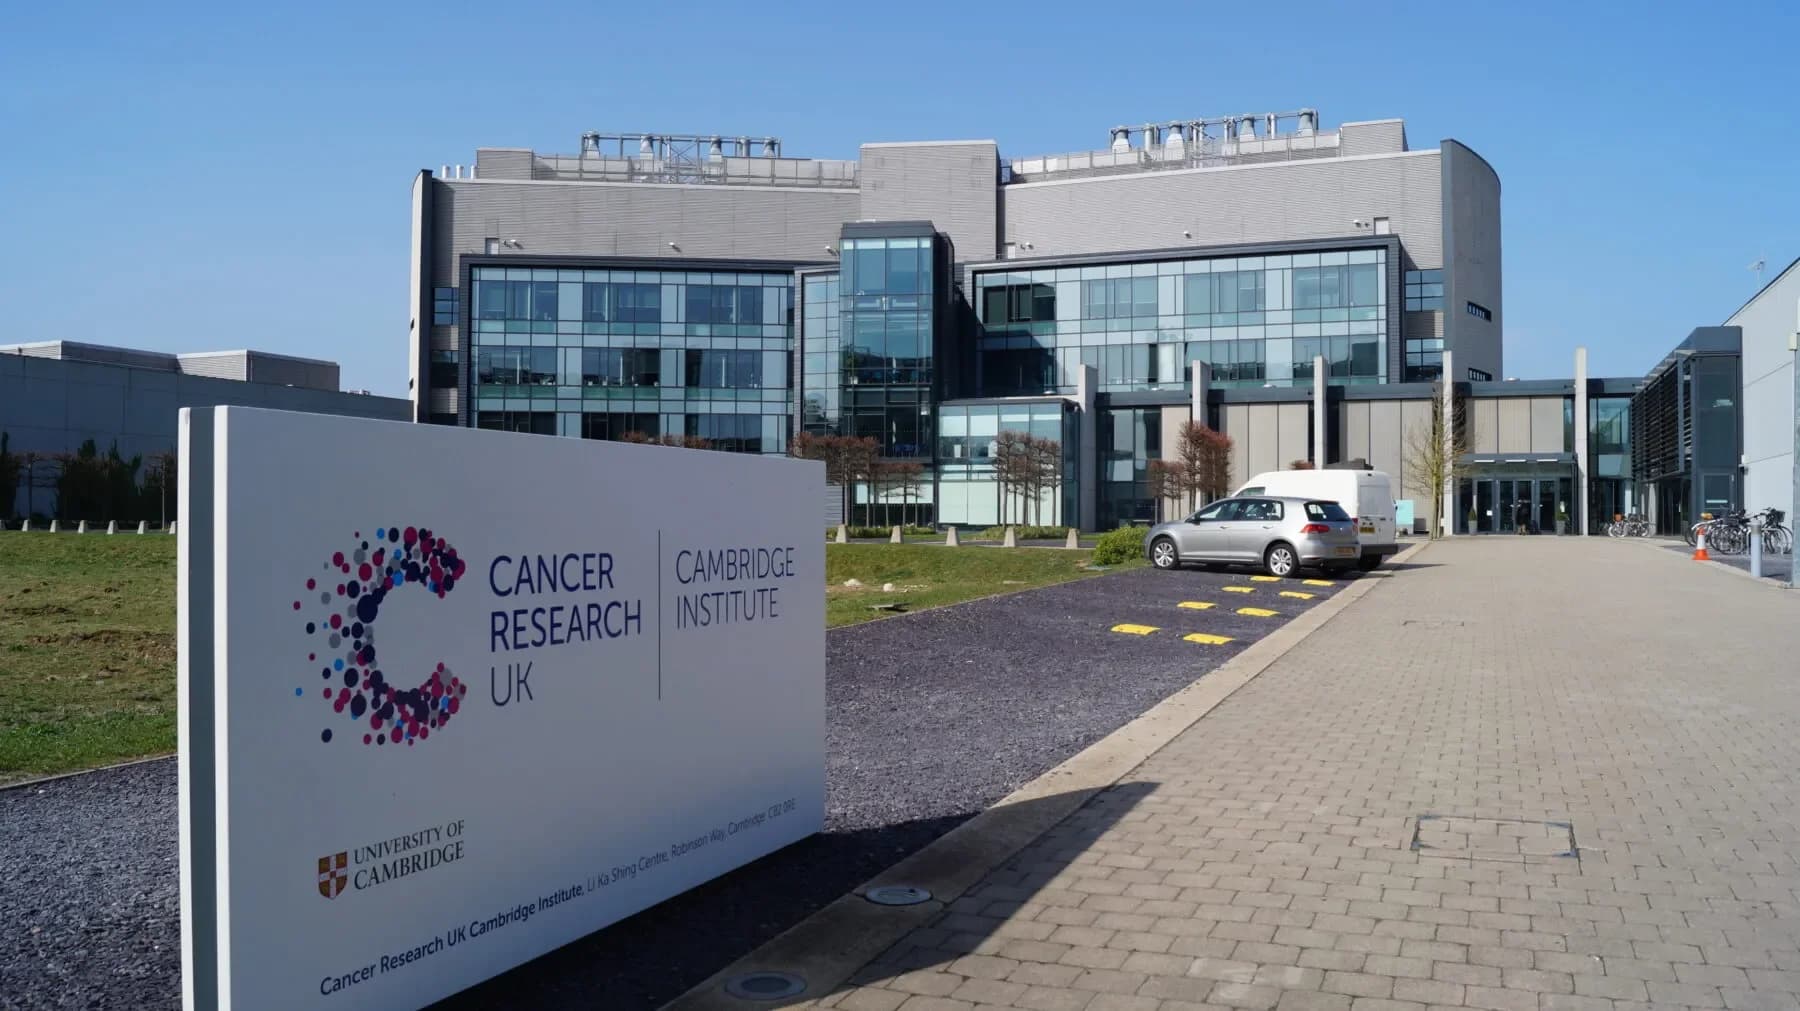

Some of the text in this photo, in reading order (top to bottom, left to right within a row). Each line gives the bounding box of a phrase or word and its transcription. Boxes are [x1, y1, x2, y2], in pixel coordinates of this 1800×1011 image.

[489, 553, 614, 597] CANCER
[675, 547, 795, 585] CAMBRIDGE
[491, 600, 641, 653] RESEARCH
[676, 588, 779, 630] INSTITUTE
[491, 661, 533, 706] UK
[354, 819, 465, 864] UNIVERSITY OF
[353, 840, 465, 890] CAMBRIDGE
[320, 963, 376, 996] Cancer
[380, 936, 443, 974] Research
[447, 925, 467, 946] UK
[469, 901, 536, 938] Cambridge
[538, 884, 585, 912] Institute,
[587, 878, 595, 893] Li
[597, 874, 609, 889] Ka
[611, 862, 637, 883] Shing
[671, 834, 708, 858] Robinson
[768, 804, 782, 820] CB2
